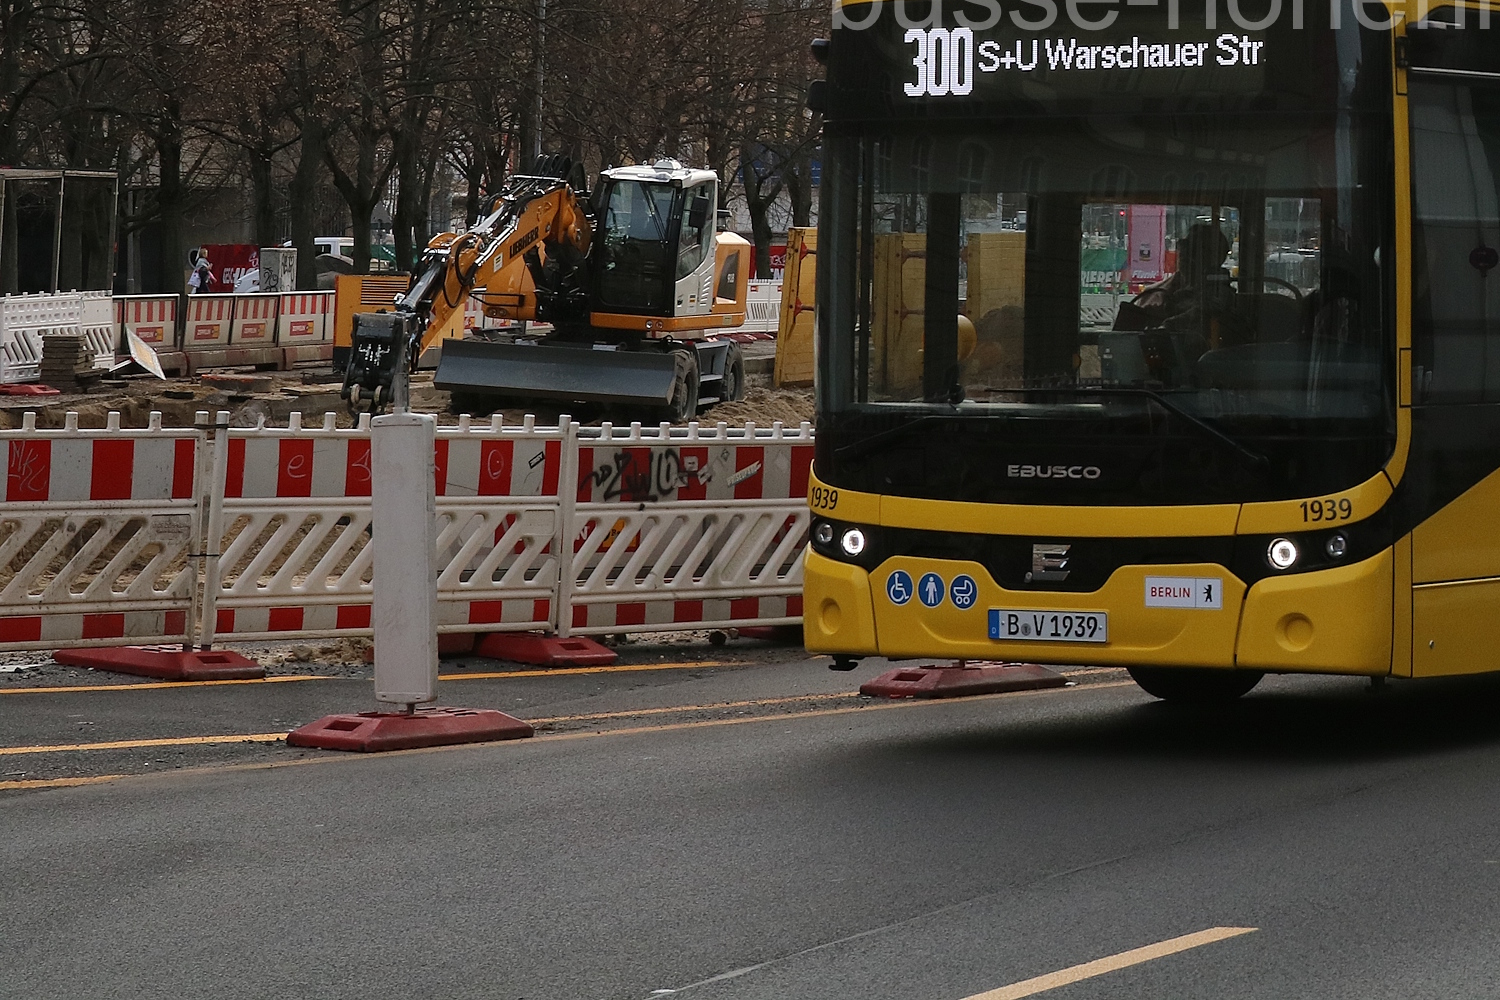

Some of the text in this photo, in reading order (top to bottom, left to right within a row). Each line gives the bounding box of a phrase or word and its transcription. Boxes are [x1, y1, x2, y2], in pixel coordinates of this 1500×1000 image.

[903, 27, 1263, 97] 300 S+U Warschauer Str
[509, 226, 540, 259] LIEBHERR
[1007, 463, 1102, 480] EBUSCO
[810, 485, 838, 511] 1939
[1299, 497, 1353, 523] 1939
[1150, 585, 1191, 599] BERLIN
[1006, 614, 1019, 637] B
[1033, 615, 1048, 638] V
[1050, 615, 1098, 640] 1939
